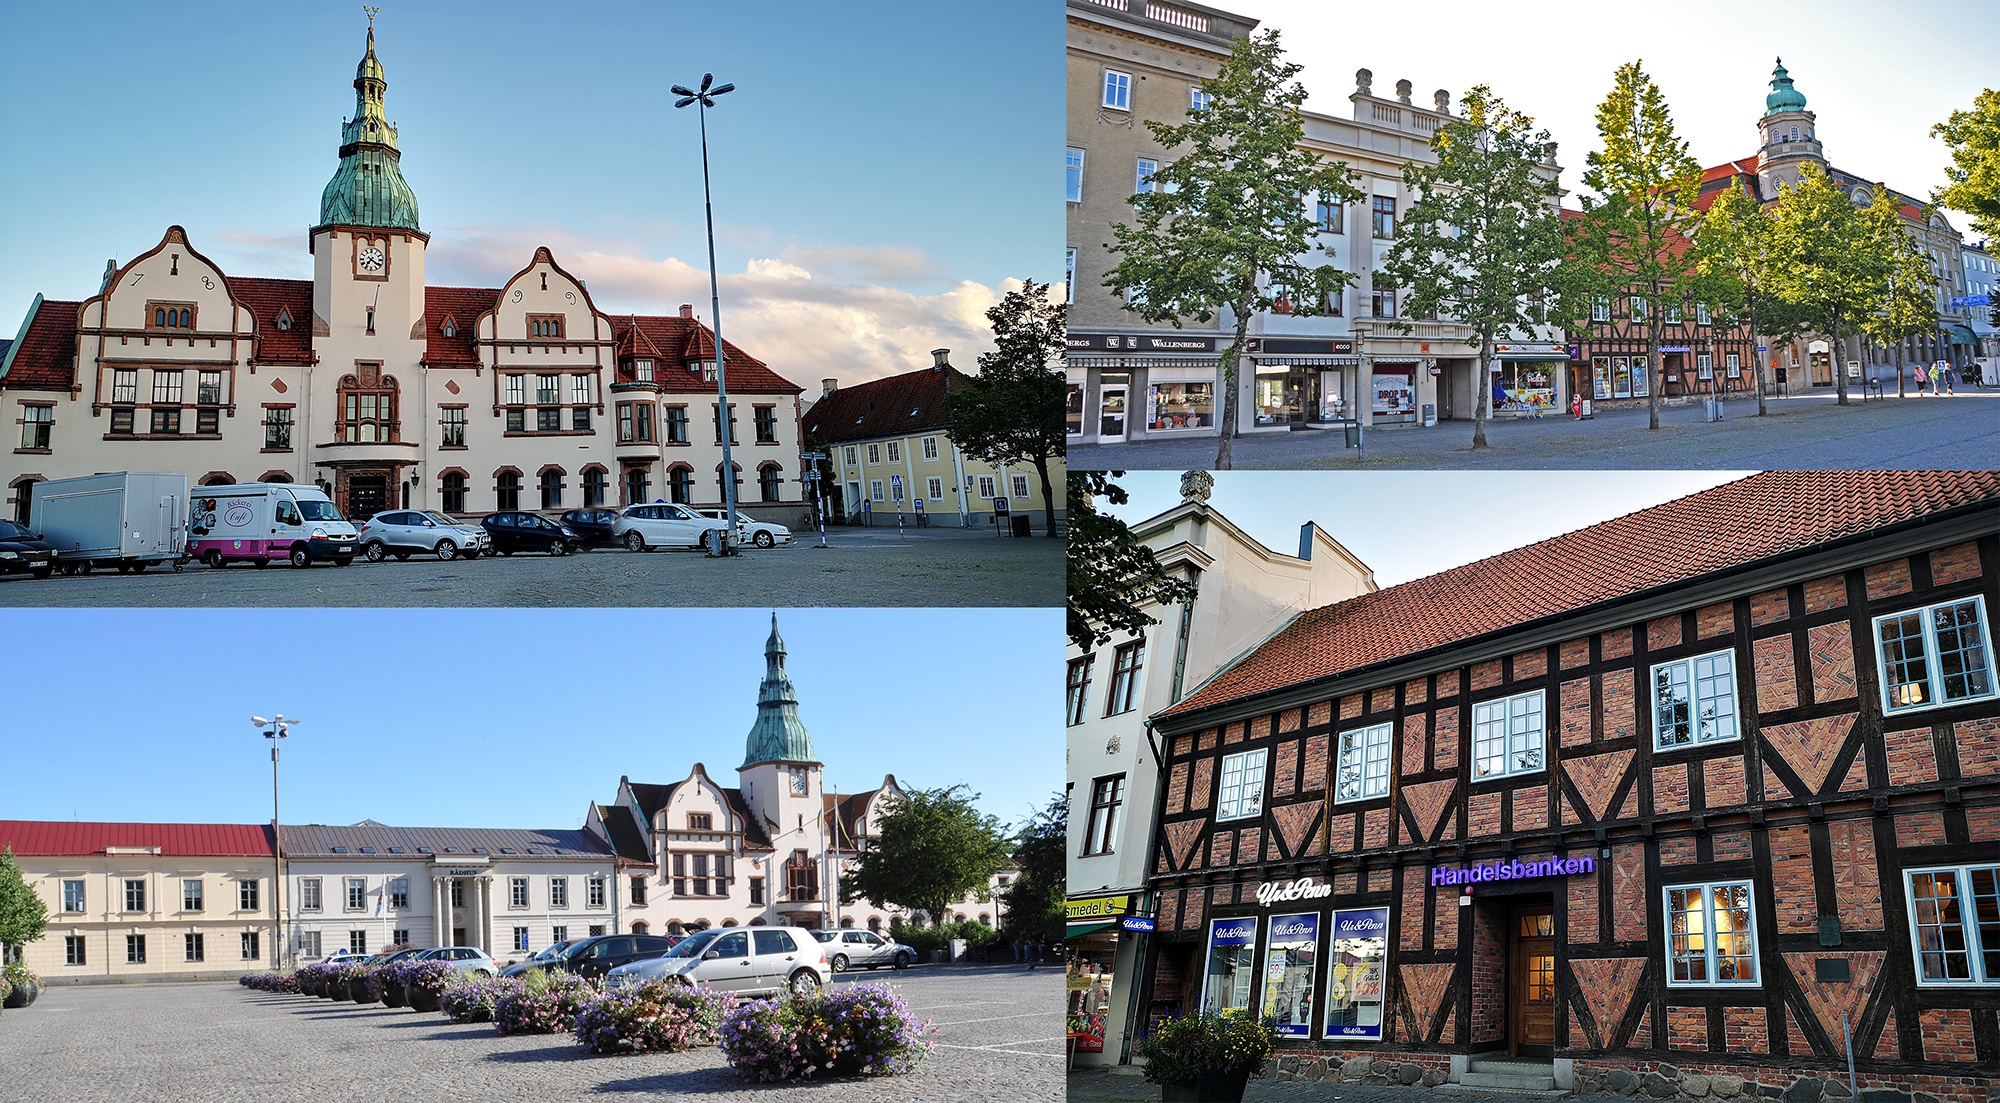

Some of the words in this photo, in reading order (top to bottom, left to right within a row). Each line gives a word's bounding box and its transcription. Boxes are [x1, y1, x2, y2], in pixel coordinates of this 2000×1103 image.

[1378, 390, 1398, 398] DROP
[1400, 390, 1408, 398] IN
[1431, 855, 1595, 886] Handelsbanken
[1355, 981, 1380, 996] 50%
